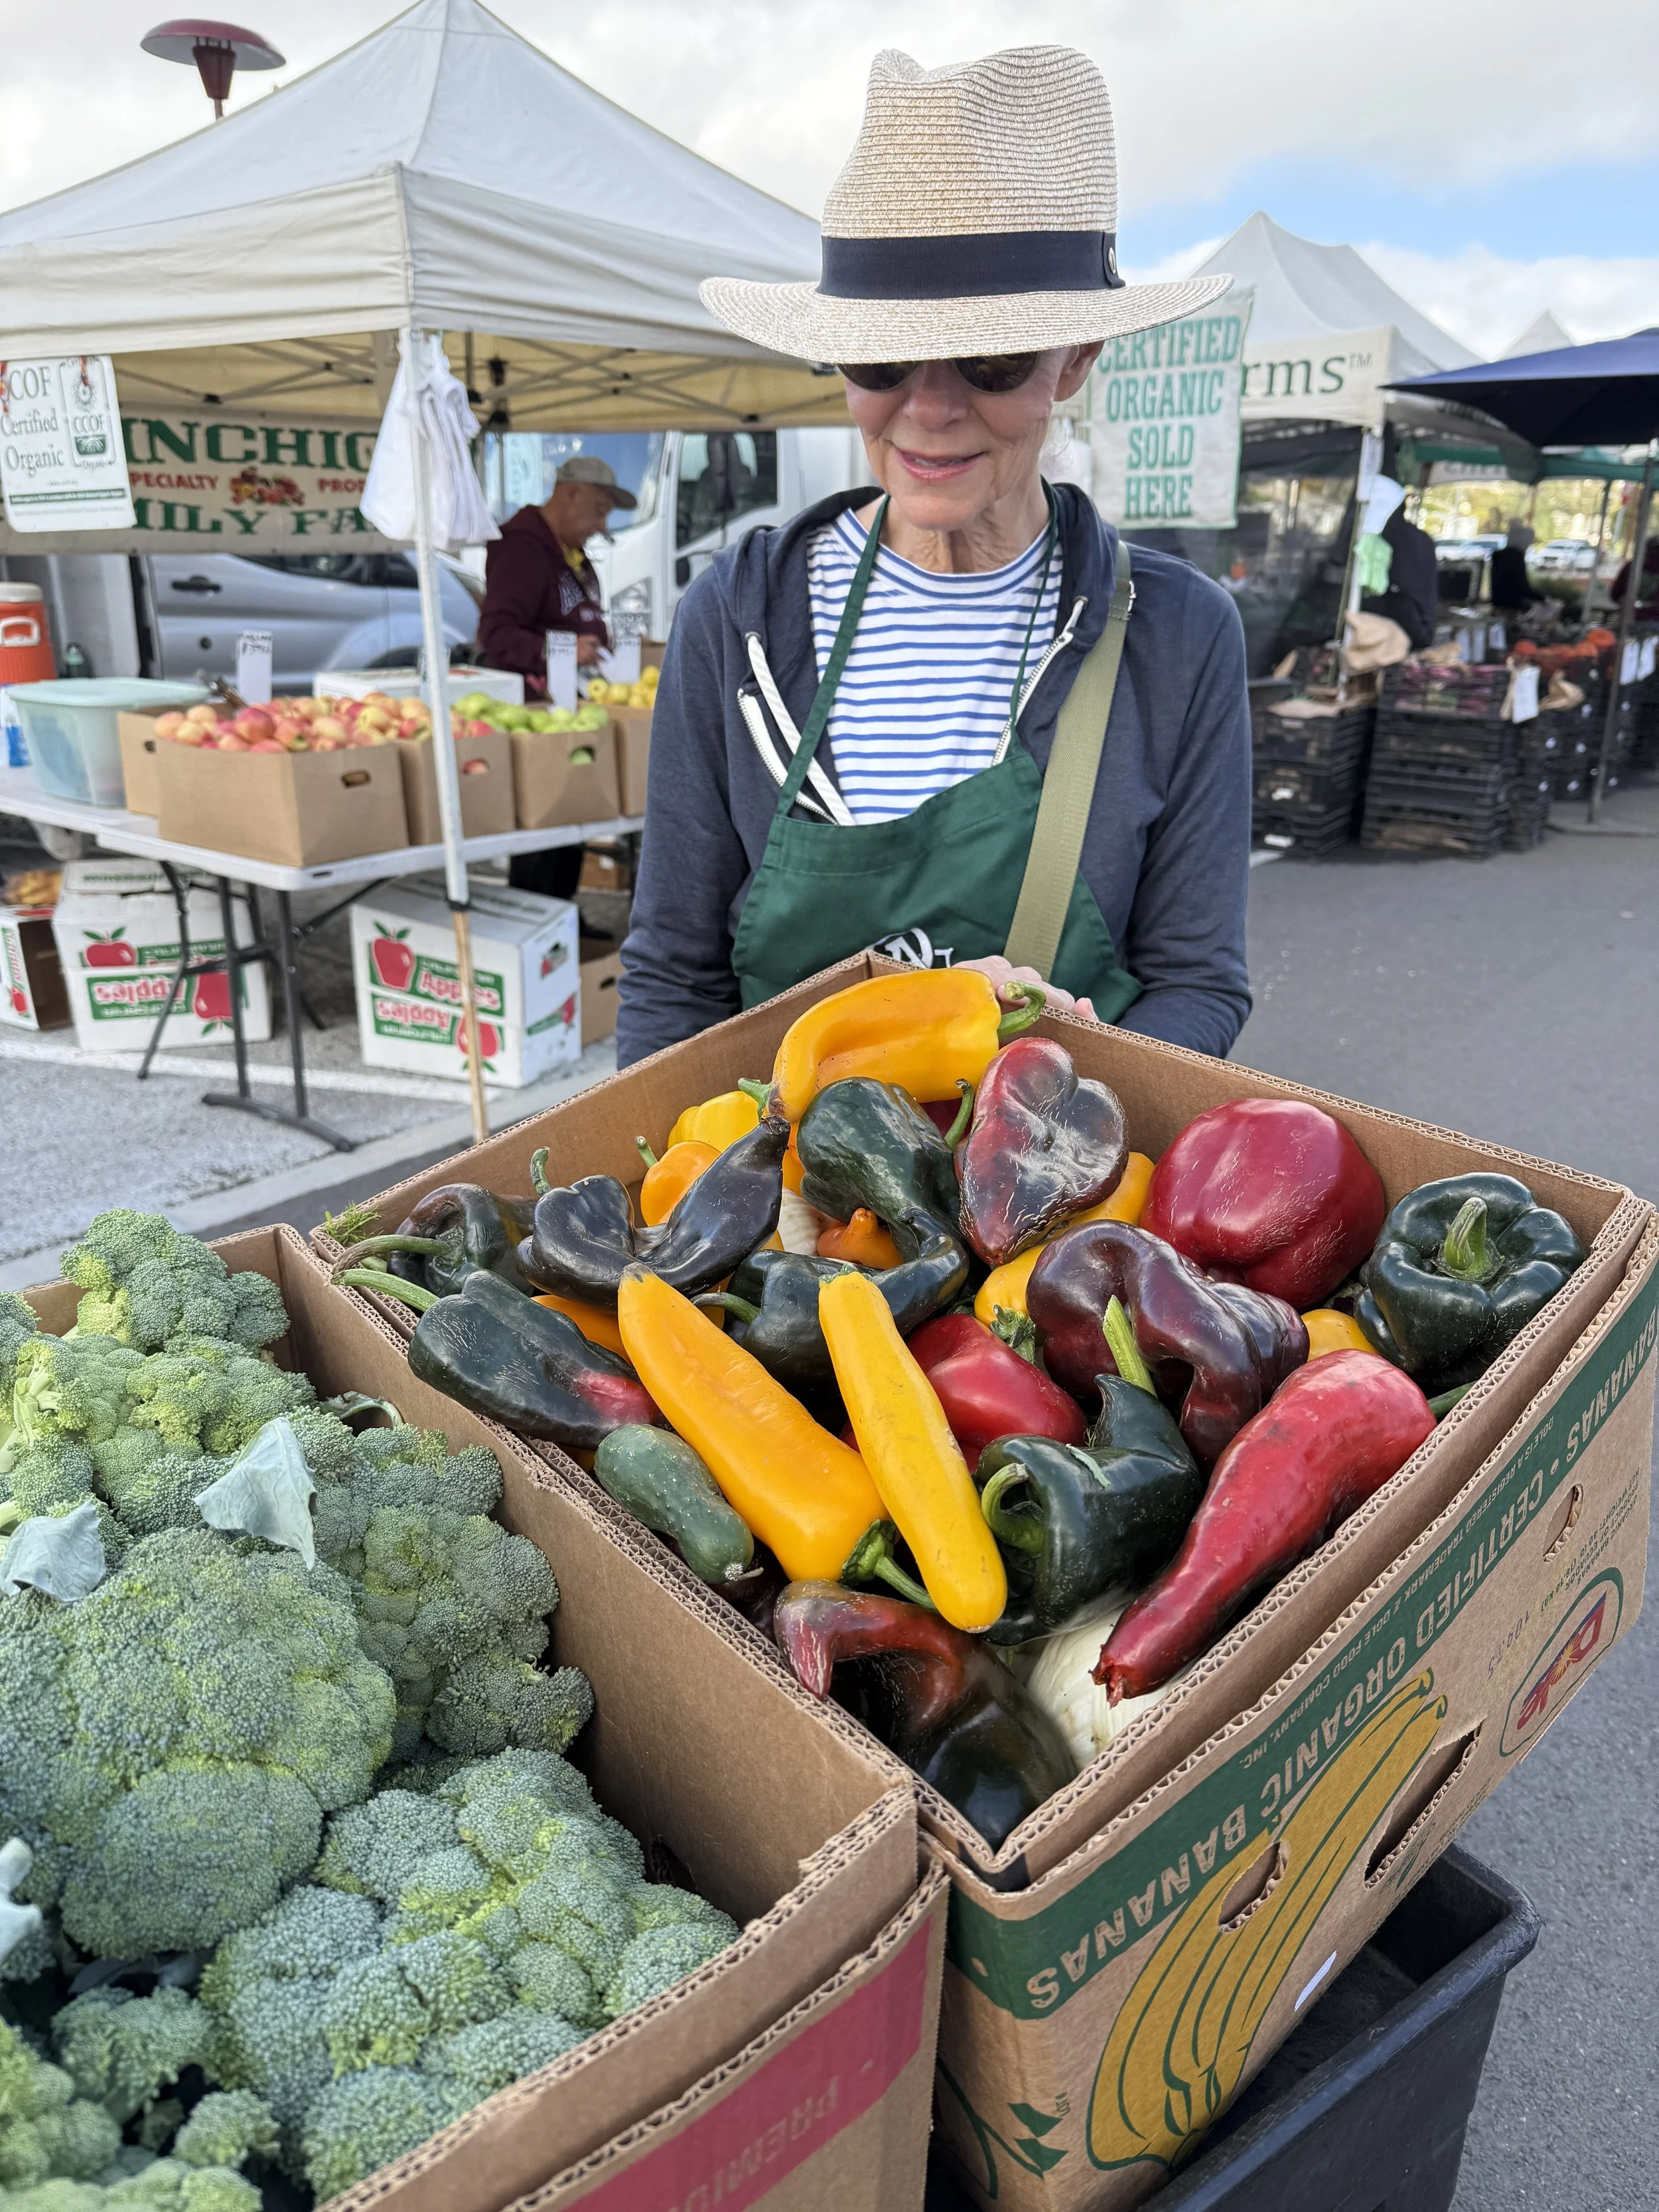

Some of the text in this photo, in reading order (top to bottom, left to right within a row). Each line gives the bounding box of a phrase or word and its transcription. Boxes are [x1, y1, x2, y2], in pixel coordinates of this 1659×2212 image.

[1097, 316, 1240, 374] CERTIFIED
[5, 366, 51, 402] COF
[1107, 370, 1224, 423] ORGANIC
[1, 407, 58, 437] Certified
[74, 414, 105, 432] CCOF
[6, 443, 64, 478] Organic
[1127, 424, 1194, 469] SOLD
[1123, 475, 1192, 520] HERE
[1566, 1305, 1656, 1463] BANANAS
[1525, 1443, 1533, 1461] IS
[1534, 1415, 1554, 1449] DOLE
[1518, 1455, 1524, 1469] A
[1628, 1466, 1640, 1491] NET
[1465, 1463, 1516, 1534] REGISTERED
[1599, 1491, 1628, 1528] WEIGHT:
[1565, 1479, 1639, 1591] PRODUCT OF ECUADOR
[1577, 1494, 1638, 1586] ORGANIC BANANAS
[1404, 1528, 1464, 1602] TRADEMARK
[1416, 1469, 1544, 1649] CERTIFIED
[1364, 1609, 1391, 1646] DOLE
[1333, 1640, 1362, 1678] FOOD
[1516, 1590, 1607, 1731] Dole
[1260, 1637, 1406, 1818] ORGANIC
[1239, 1741, 1267, 1770] INC.
[1027, 1804, 1246, 2009] BANANAS
